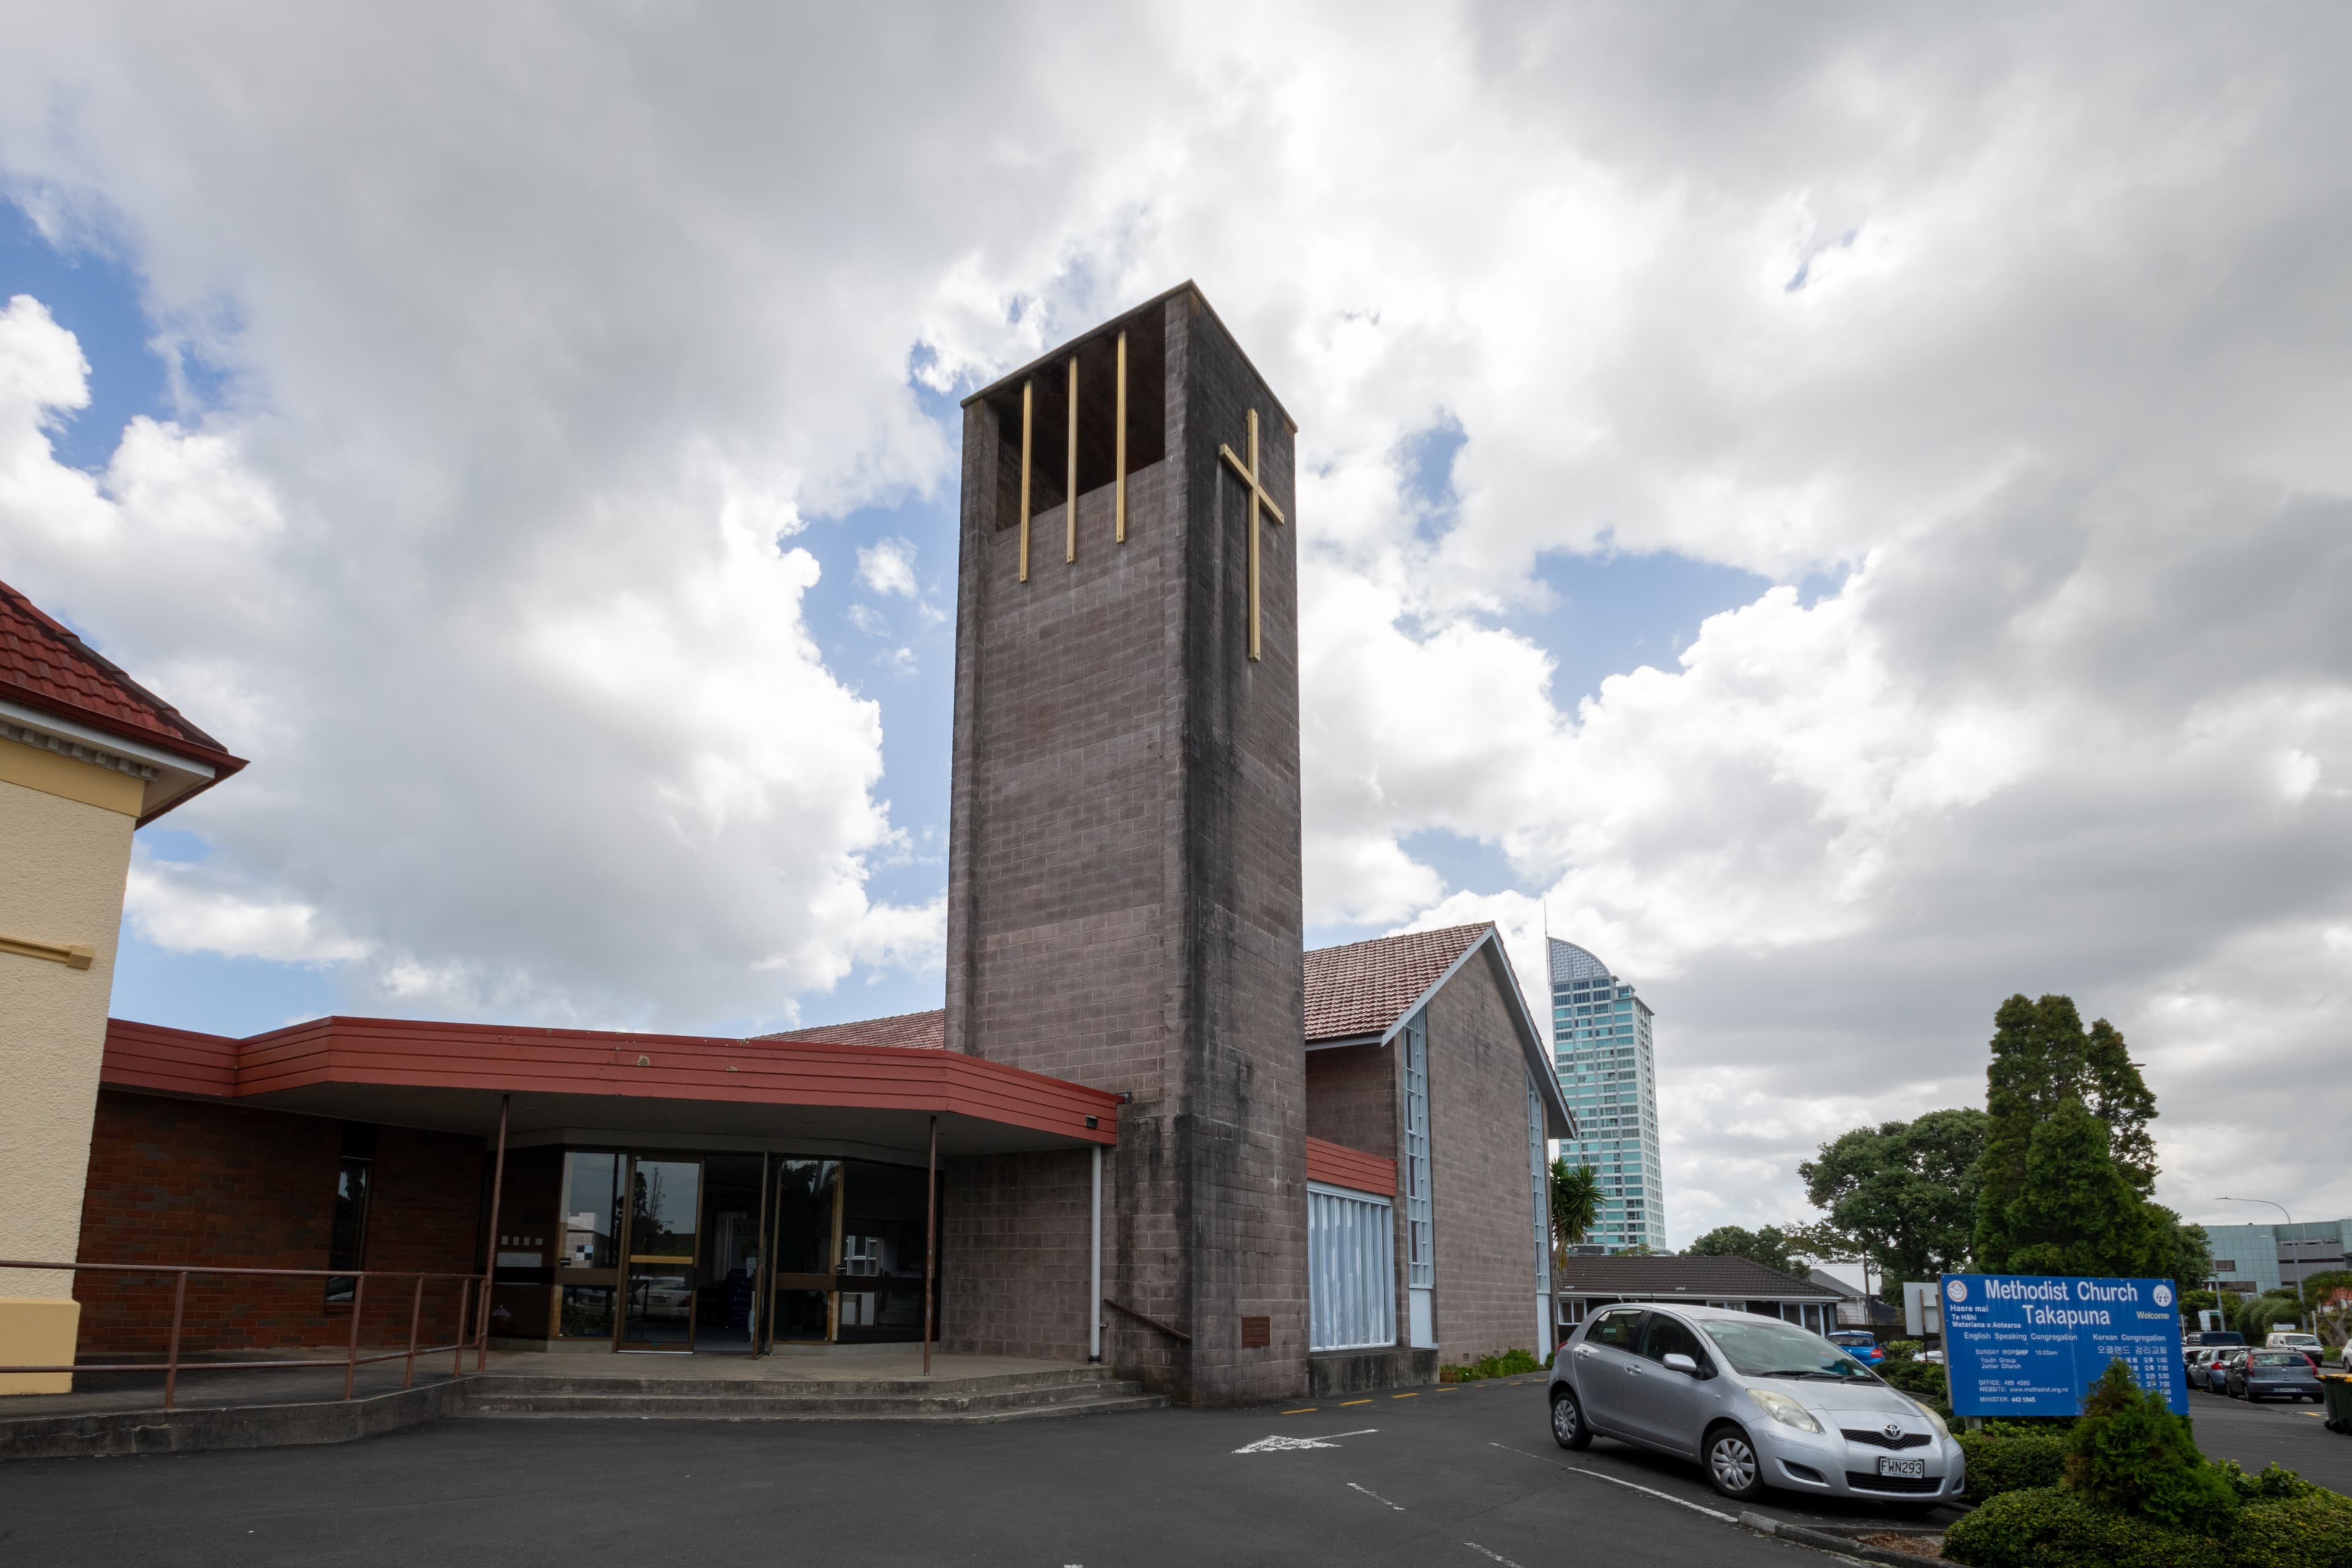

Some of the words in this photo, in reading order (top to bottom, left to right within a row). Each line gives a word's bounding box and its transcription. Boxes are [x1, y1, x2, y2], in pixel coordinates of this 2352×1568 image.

[1985, 1280, 2070, 1301] Methodist
[2077, 1281, 2138, 1302] Church
[1975, 1304, 1989, 1313] mai
[2022, 1305, 2110, 1329] Takapuna
[2136, 1310, 2170, 1320] Welcome
[1964, 1332, 1991, 1341] English
[1994, 1332, 2027, 1342] Speaking
[2030, 1332, 2078, 1342] Congregation
[2120, 1333, 2166, 1343] Congregation
[2097, 1345, 2132, 1354] 오클랜드
[2135, 1346, 2168, 1355] 감리교회
[1882, 1460, 1921, 1474] FWN293
